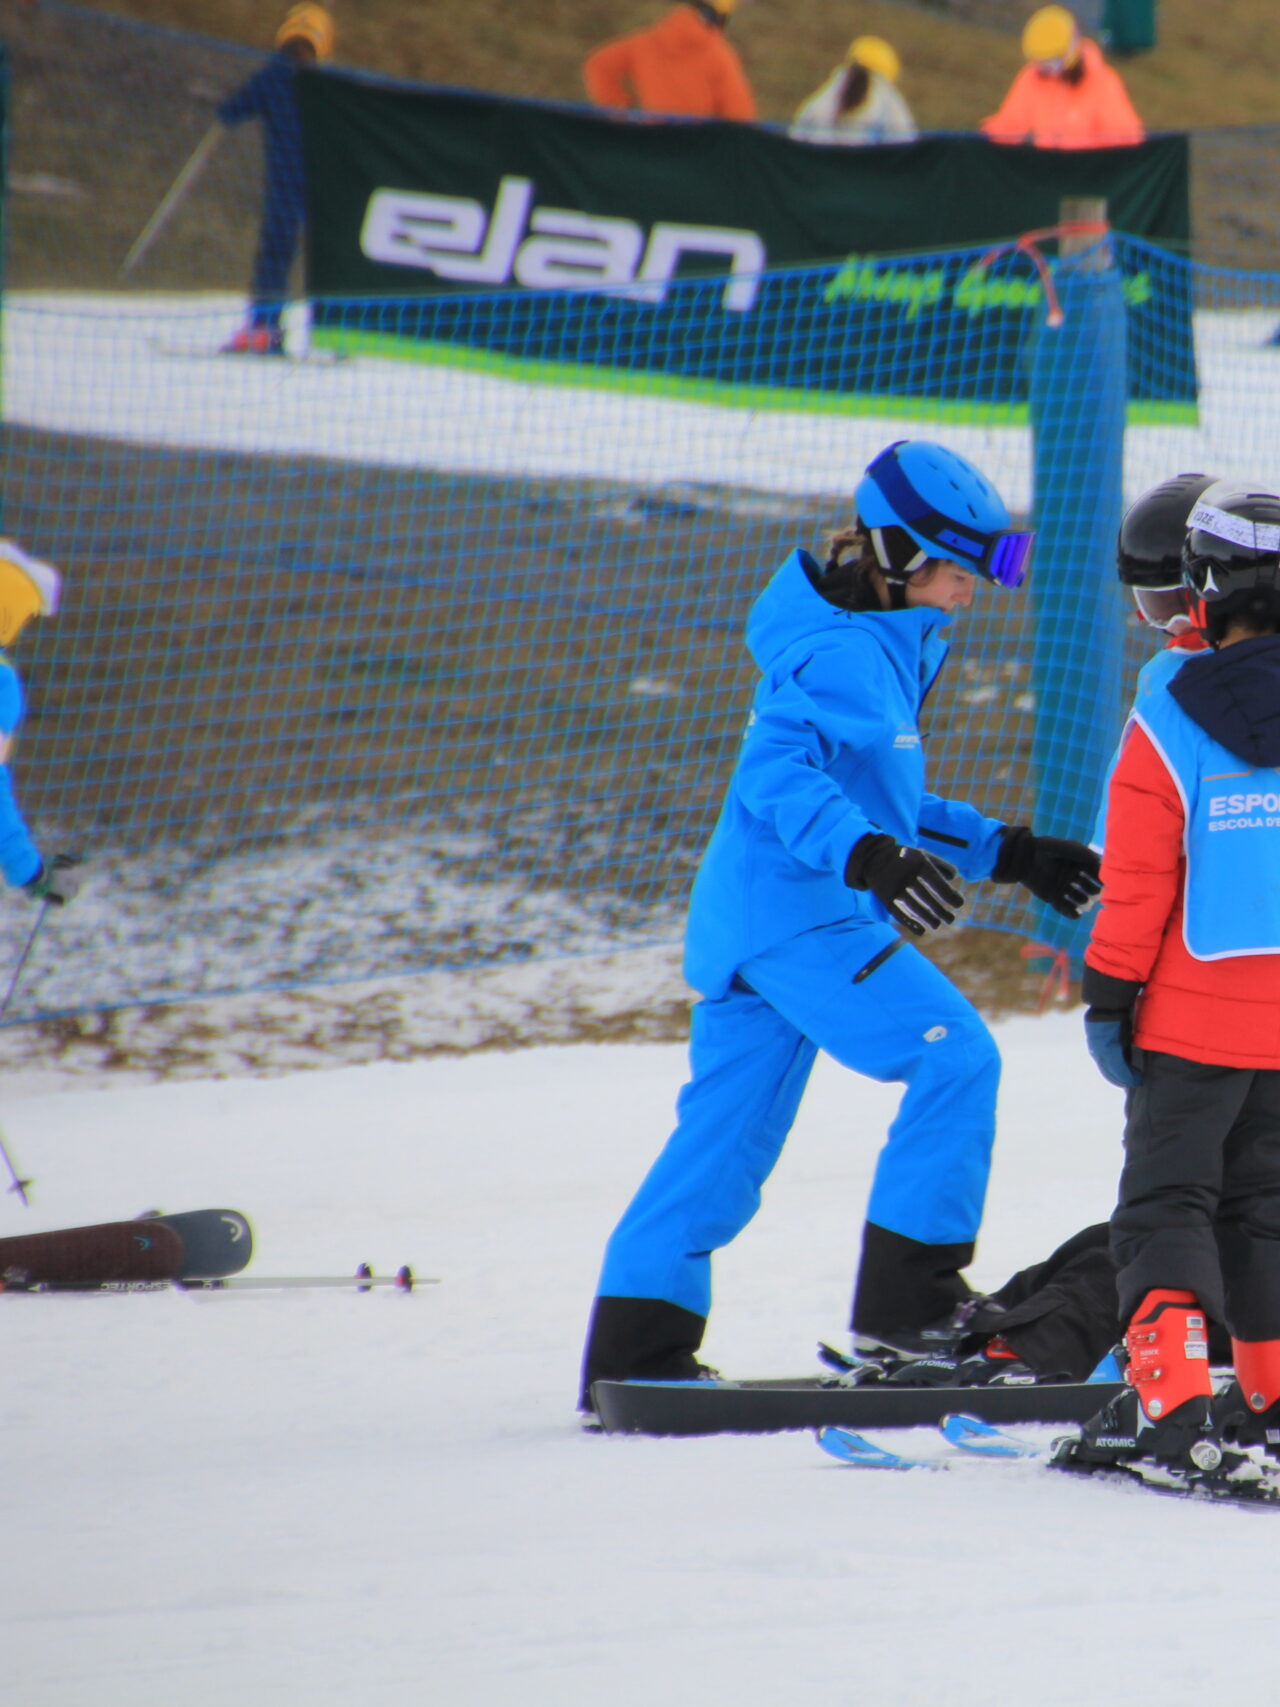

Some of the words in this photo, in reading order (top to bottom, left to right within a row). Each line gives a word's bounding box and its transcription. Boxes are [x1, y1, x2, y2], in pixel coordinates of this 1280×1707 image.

[360, 175, 766, 311] elan
[1208, 818, 1263, 832] ESCOLA
[1096, 1437, 1136, 1447] ATOMIC
